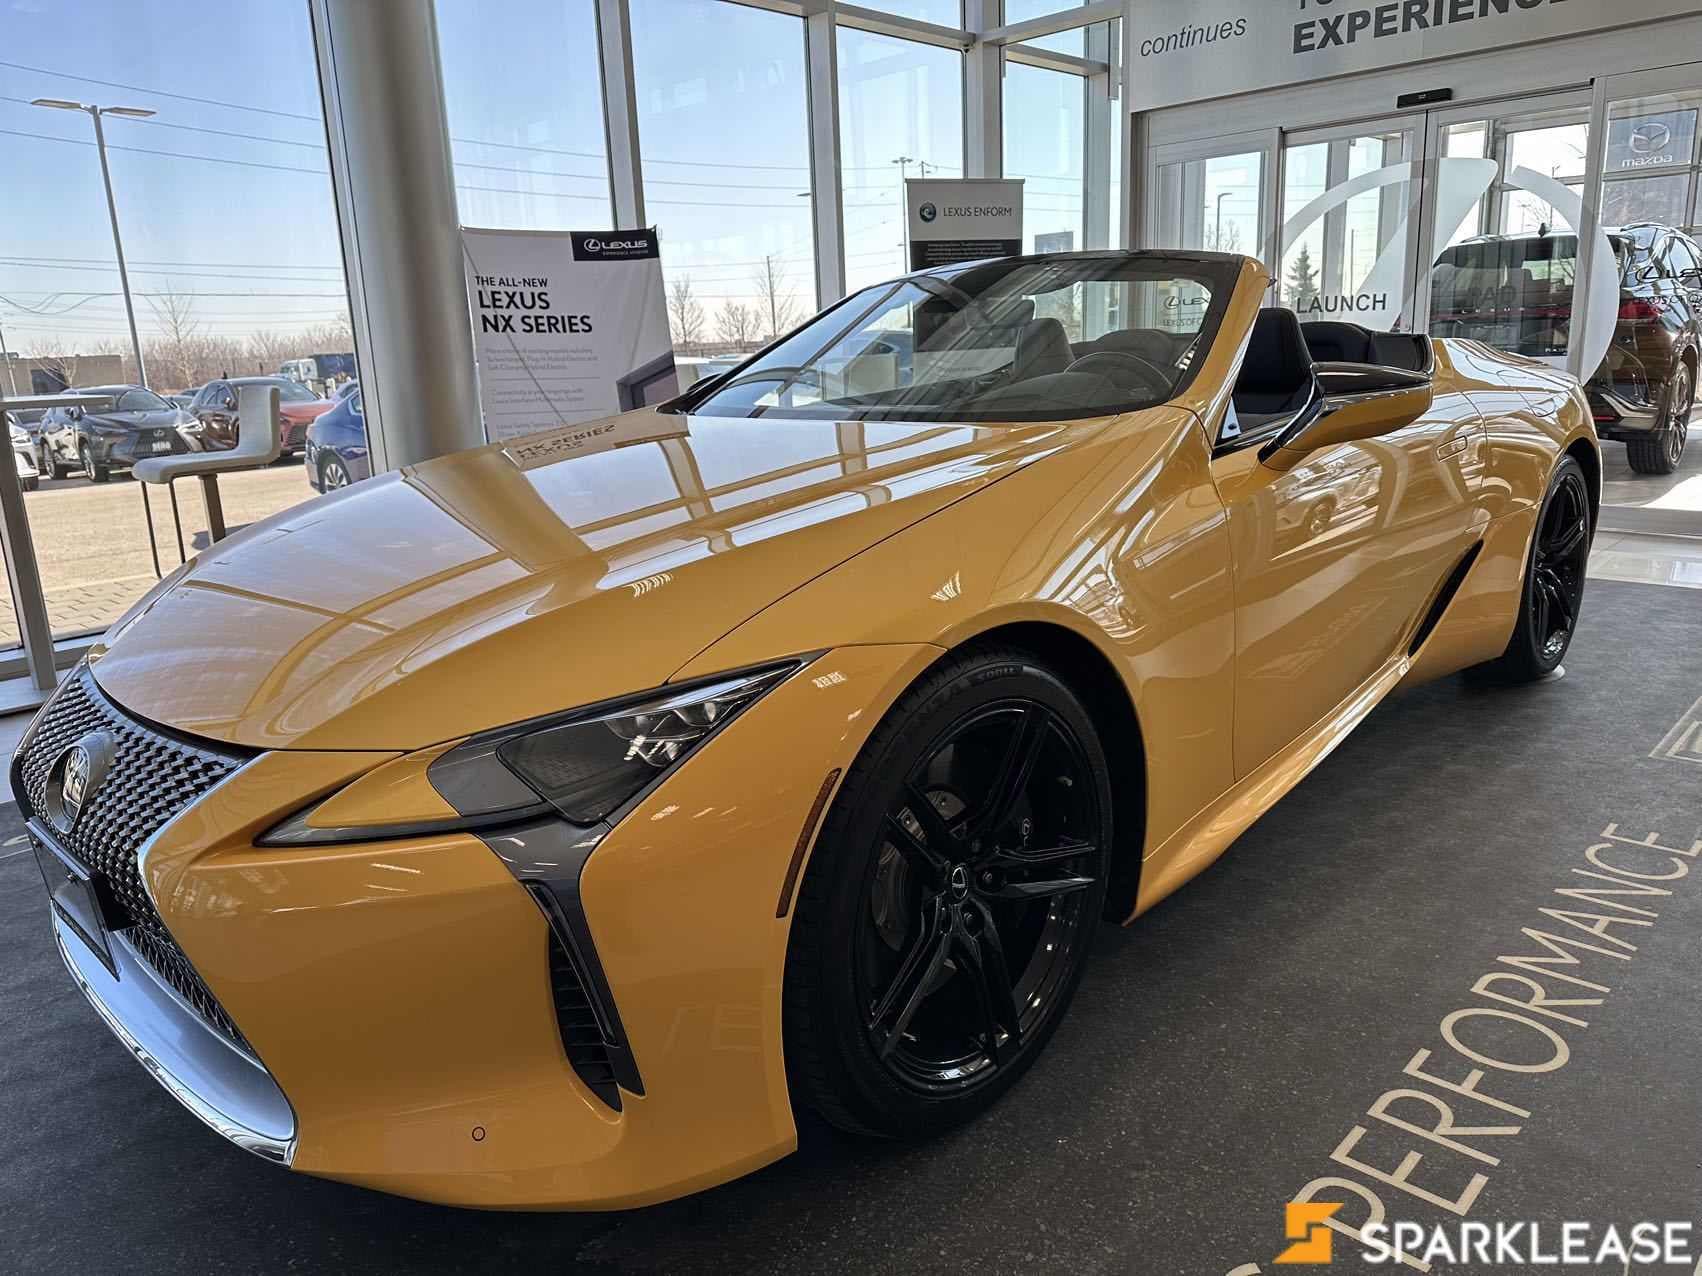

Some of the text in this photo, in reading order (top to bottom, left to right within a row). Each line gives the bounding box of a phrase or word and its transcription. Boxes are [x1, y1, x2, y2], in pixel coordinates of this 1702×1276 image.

[1140, 18, 1247, 57] continues
[943, 207, 1012, 217] LEXUS ENFORM
[602, 240, 648, 249] LEXUS
[475, 276, 548, 288] THE ALL-NEW
[478, 290, 550, 310] LEXUS
[1296, 293, 1387, 314] LAUNCH
[481, 314, 592, 333] NX SERIES
[1288, 822, 1702, 1274] PERFORMANCE
